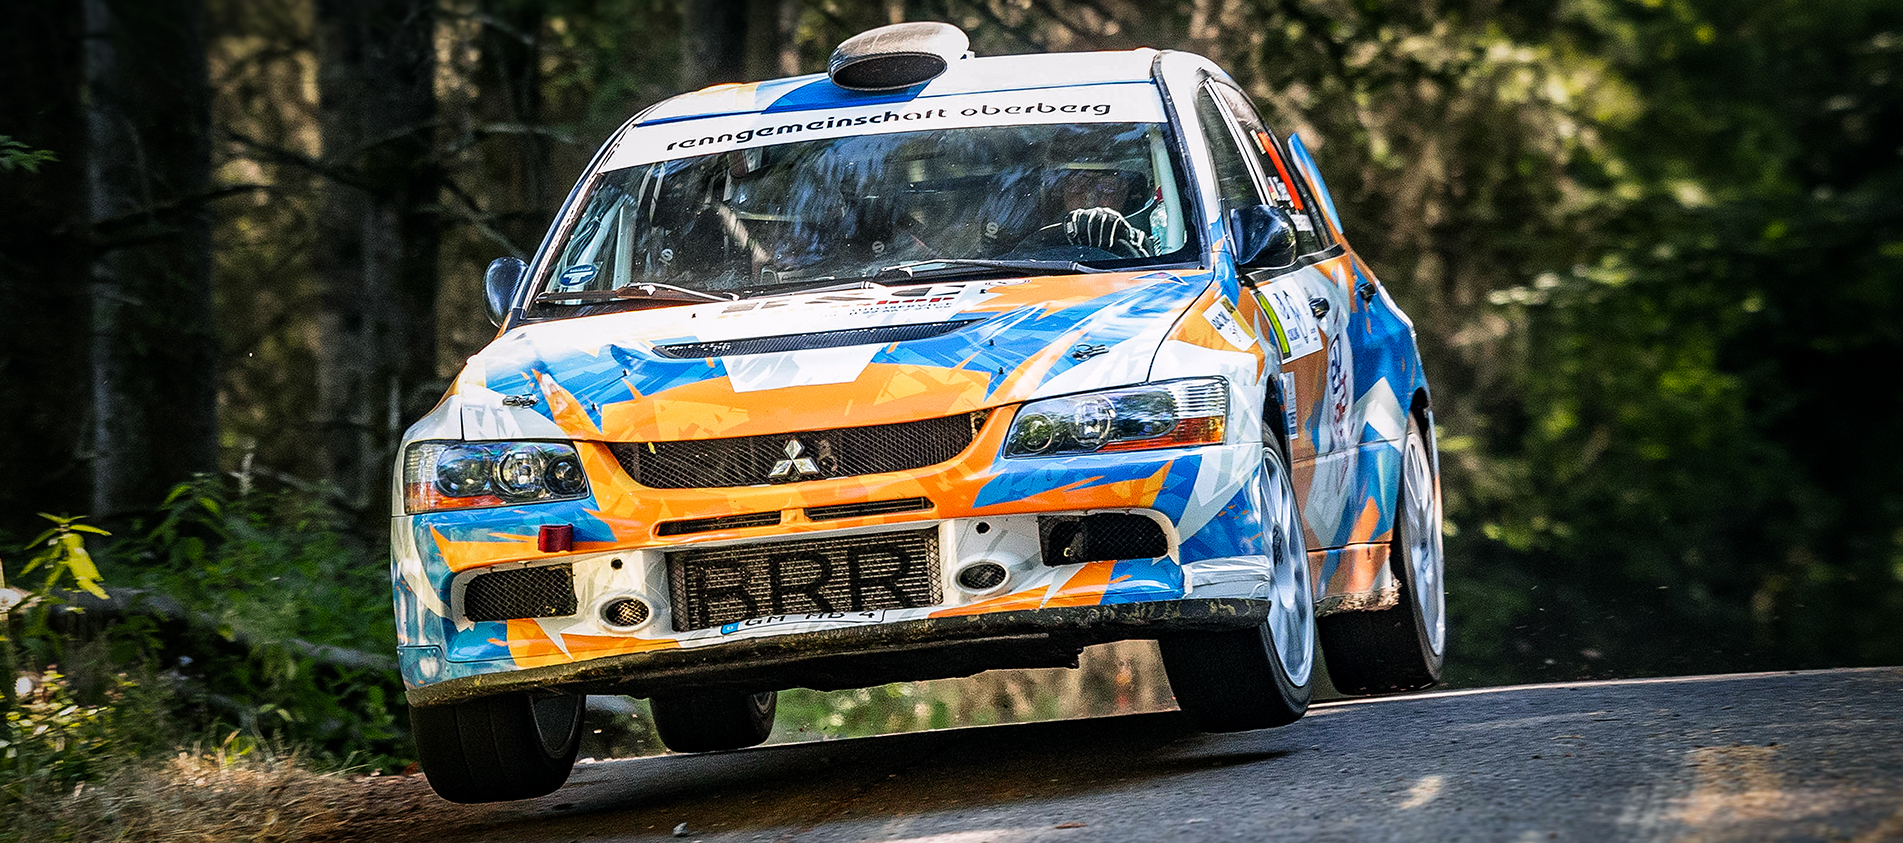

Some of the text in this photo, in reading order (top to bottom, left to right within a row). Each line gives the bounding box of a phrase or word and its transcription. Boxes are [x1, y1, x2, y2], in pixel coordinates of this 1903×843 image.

[666, 101, 1112, 151] renngemeinschaft oberberg
[695, 545, 916, 625] BRR
[744, 615, 786, 626] GM
